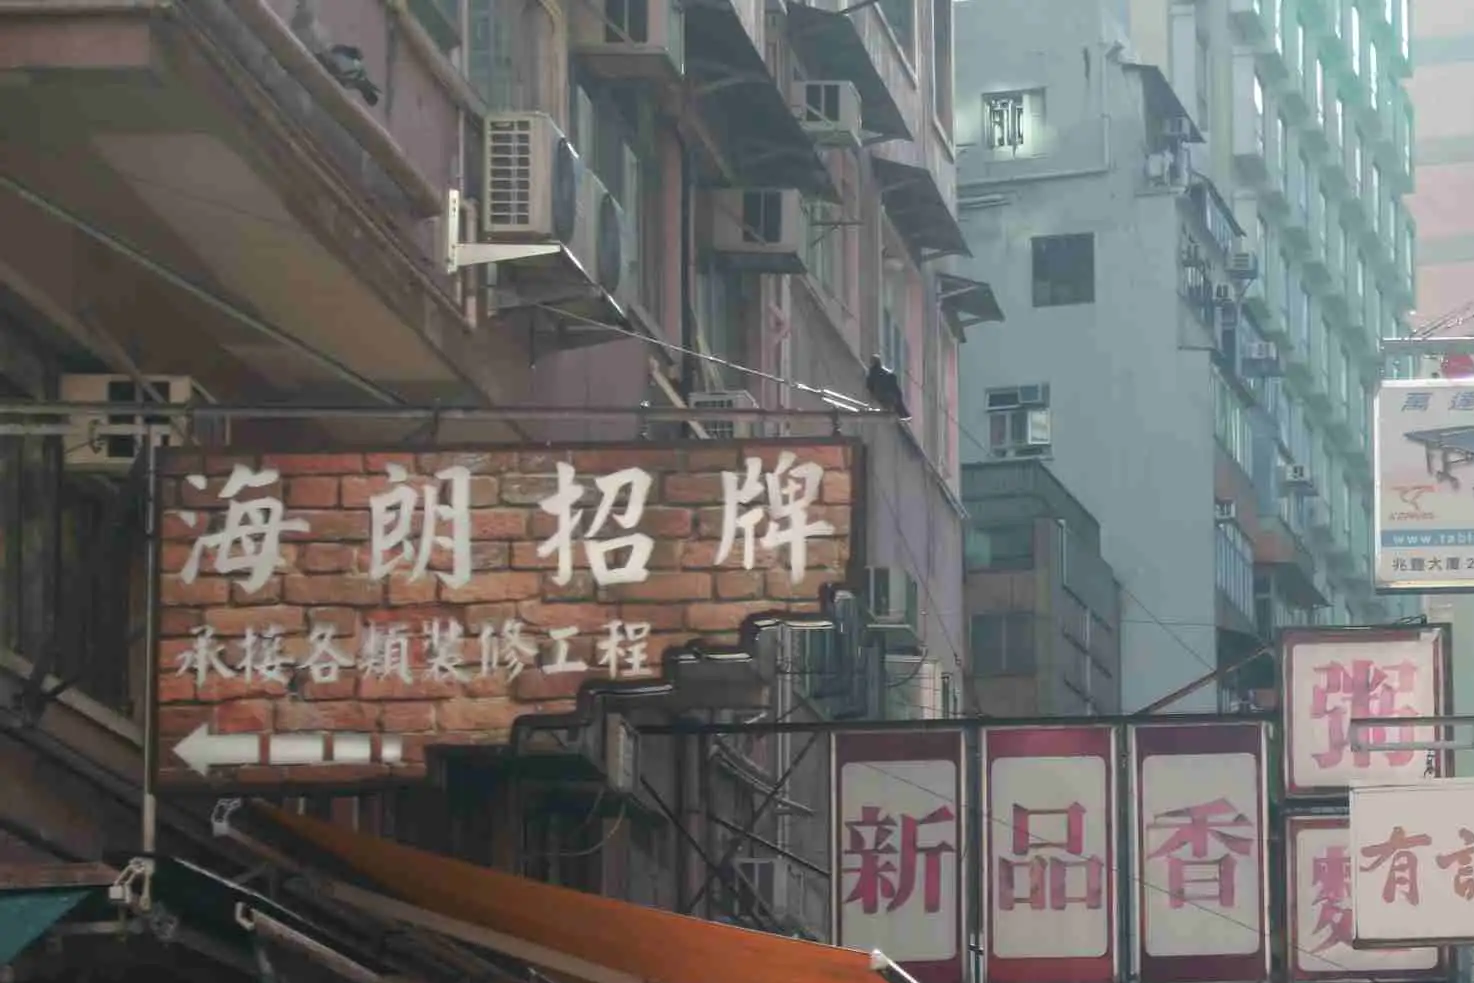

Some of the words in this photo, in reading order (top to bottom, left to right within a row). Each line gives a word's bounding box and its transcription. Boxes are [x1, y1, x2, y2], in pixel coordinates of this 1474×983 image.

[180, 452, 834, 594] 海朗招牌
[175, 619, 653, 686] 承接各類裝修工程
[1310, 659, 1419, 769] 粥
[843, 799, 1255, 915] 新品香
